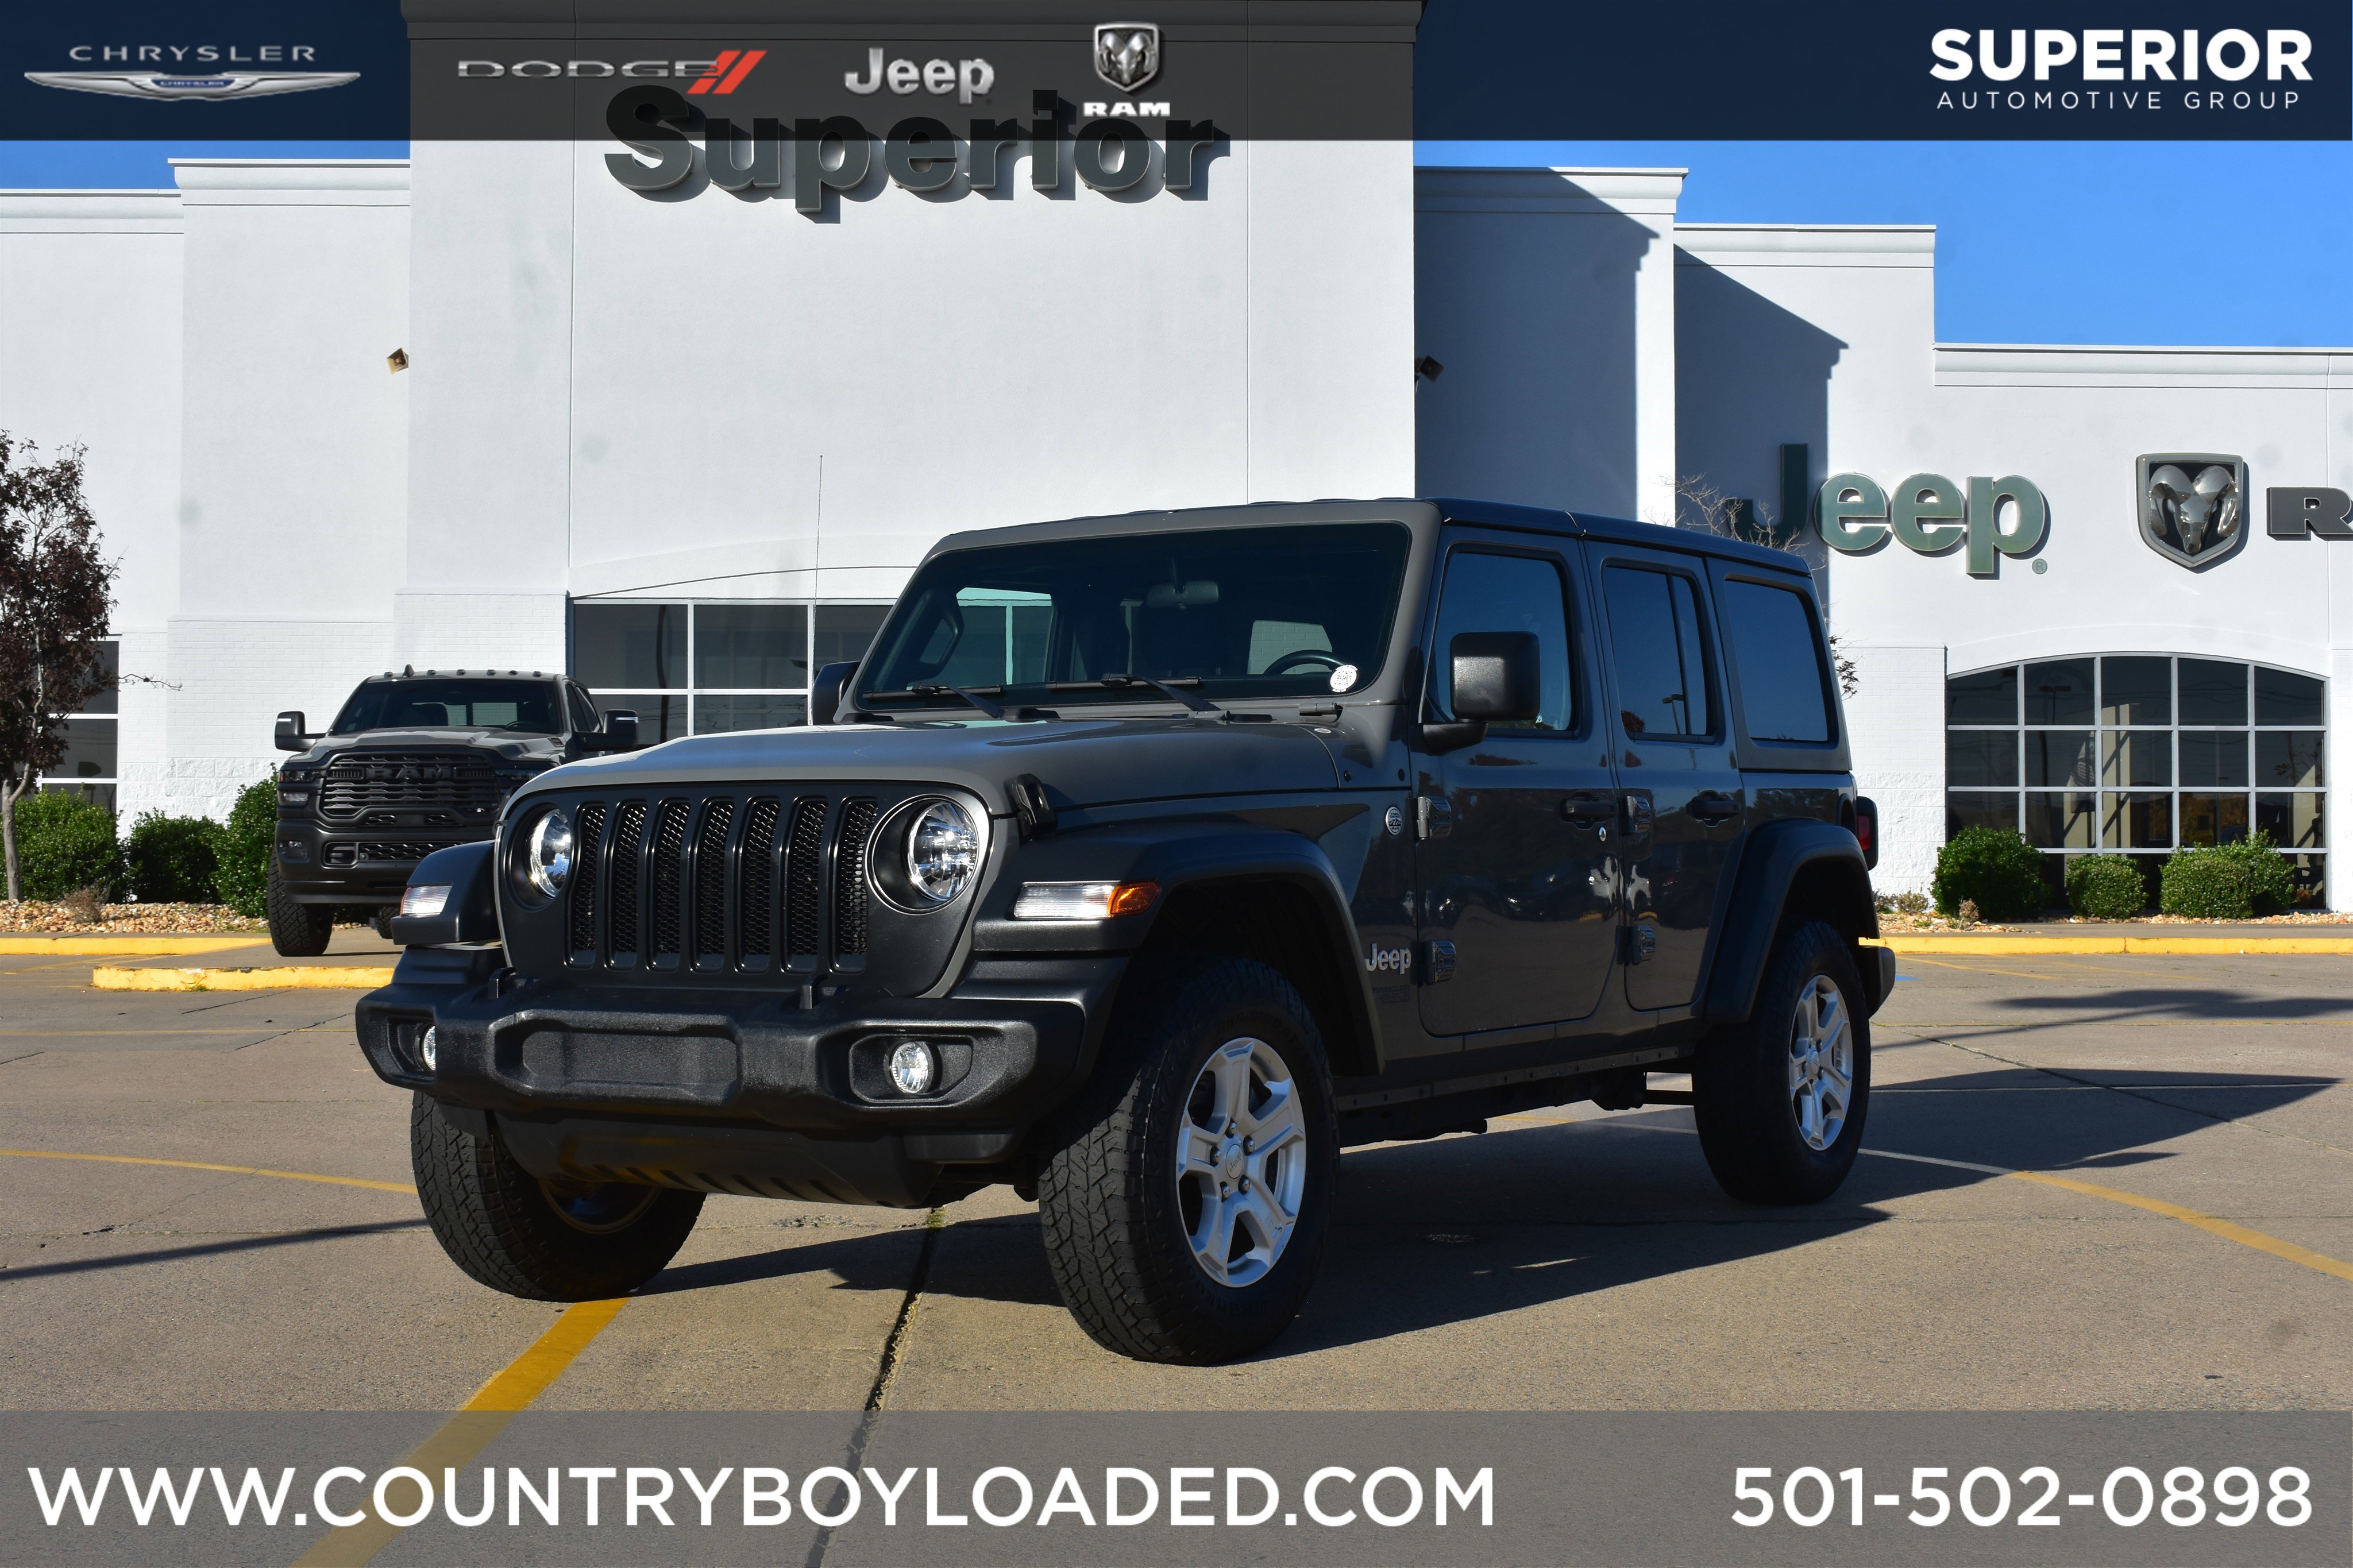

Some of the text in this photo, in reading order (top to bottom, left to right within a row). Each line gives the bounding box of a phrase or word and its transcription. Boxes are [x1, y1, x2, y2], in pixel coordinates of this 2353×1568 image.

[603, 84, 1216, 214] Superior
[1725, 443, 2046, 574] Jeep
[366, 767, 452, 780] RAM
[1364, 942, 1412, 975] Jeep
